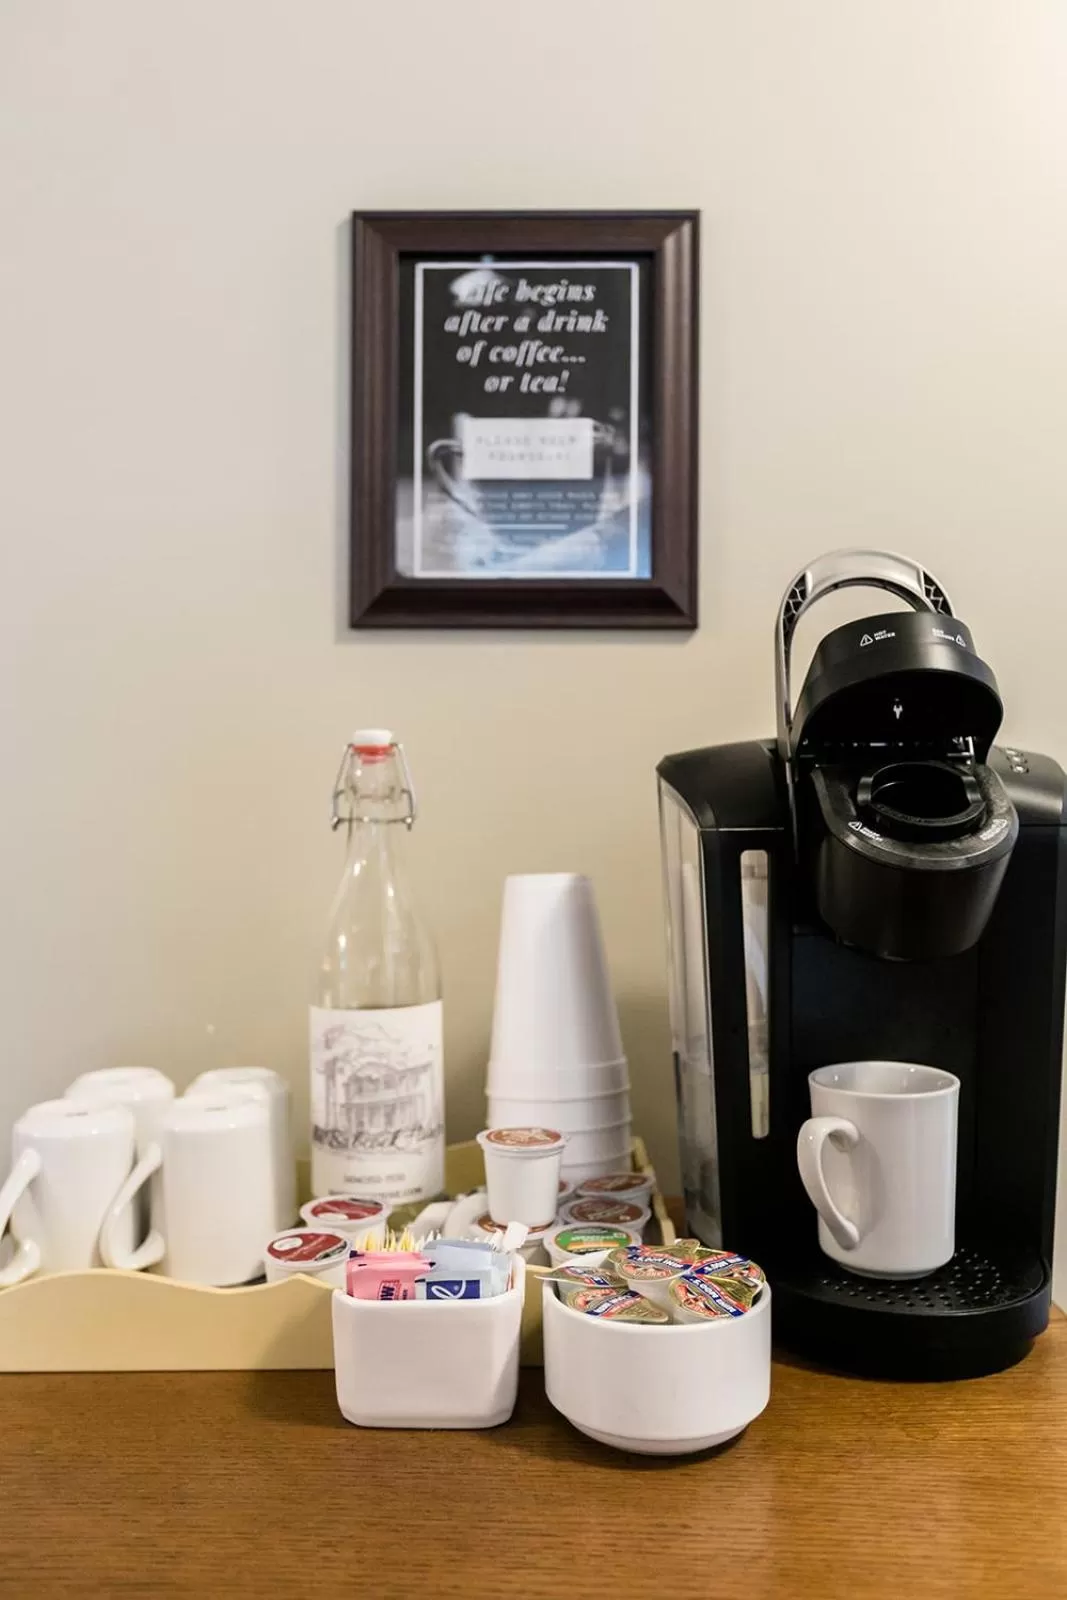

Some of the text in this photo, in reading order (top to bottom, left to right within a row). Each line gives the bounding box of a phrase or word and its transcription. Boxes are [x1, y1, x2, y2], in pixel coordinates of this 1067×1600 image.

[457, 277, 597, 306] ife begins
[443, 308, 609, 337] after a drink
[456, 339, 586, 368] of coffee...
[484, 368, 570, 393] or tea!
